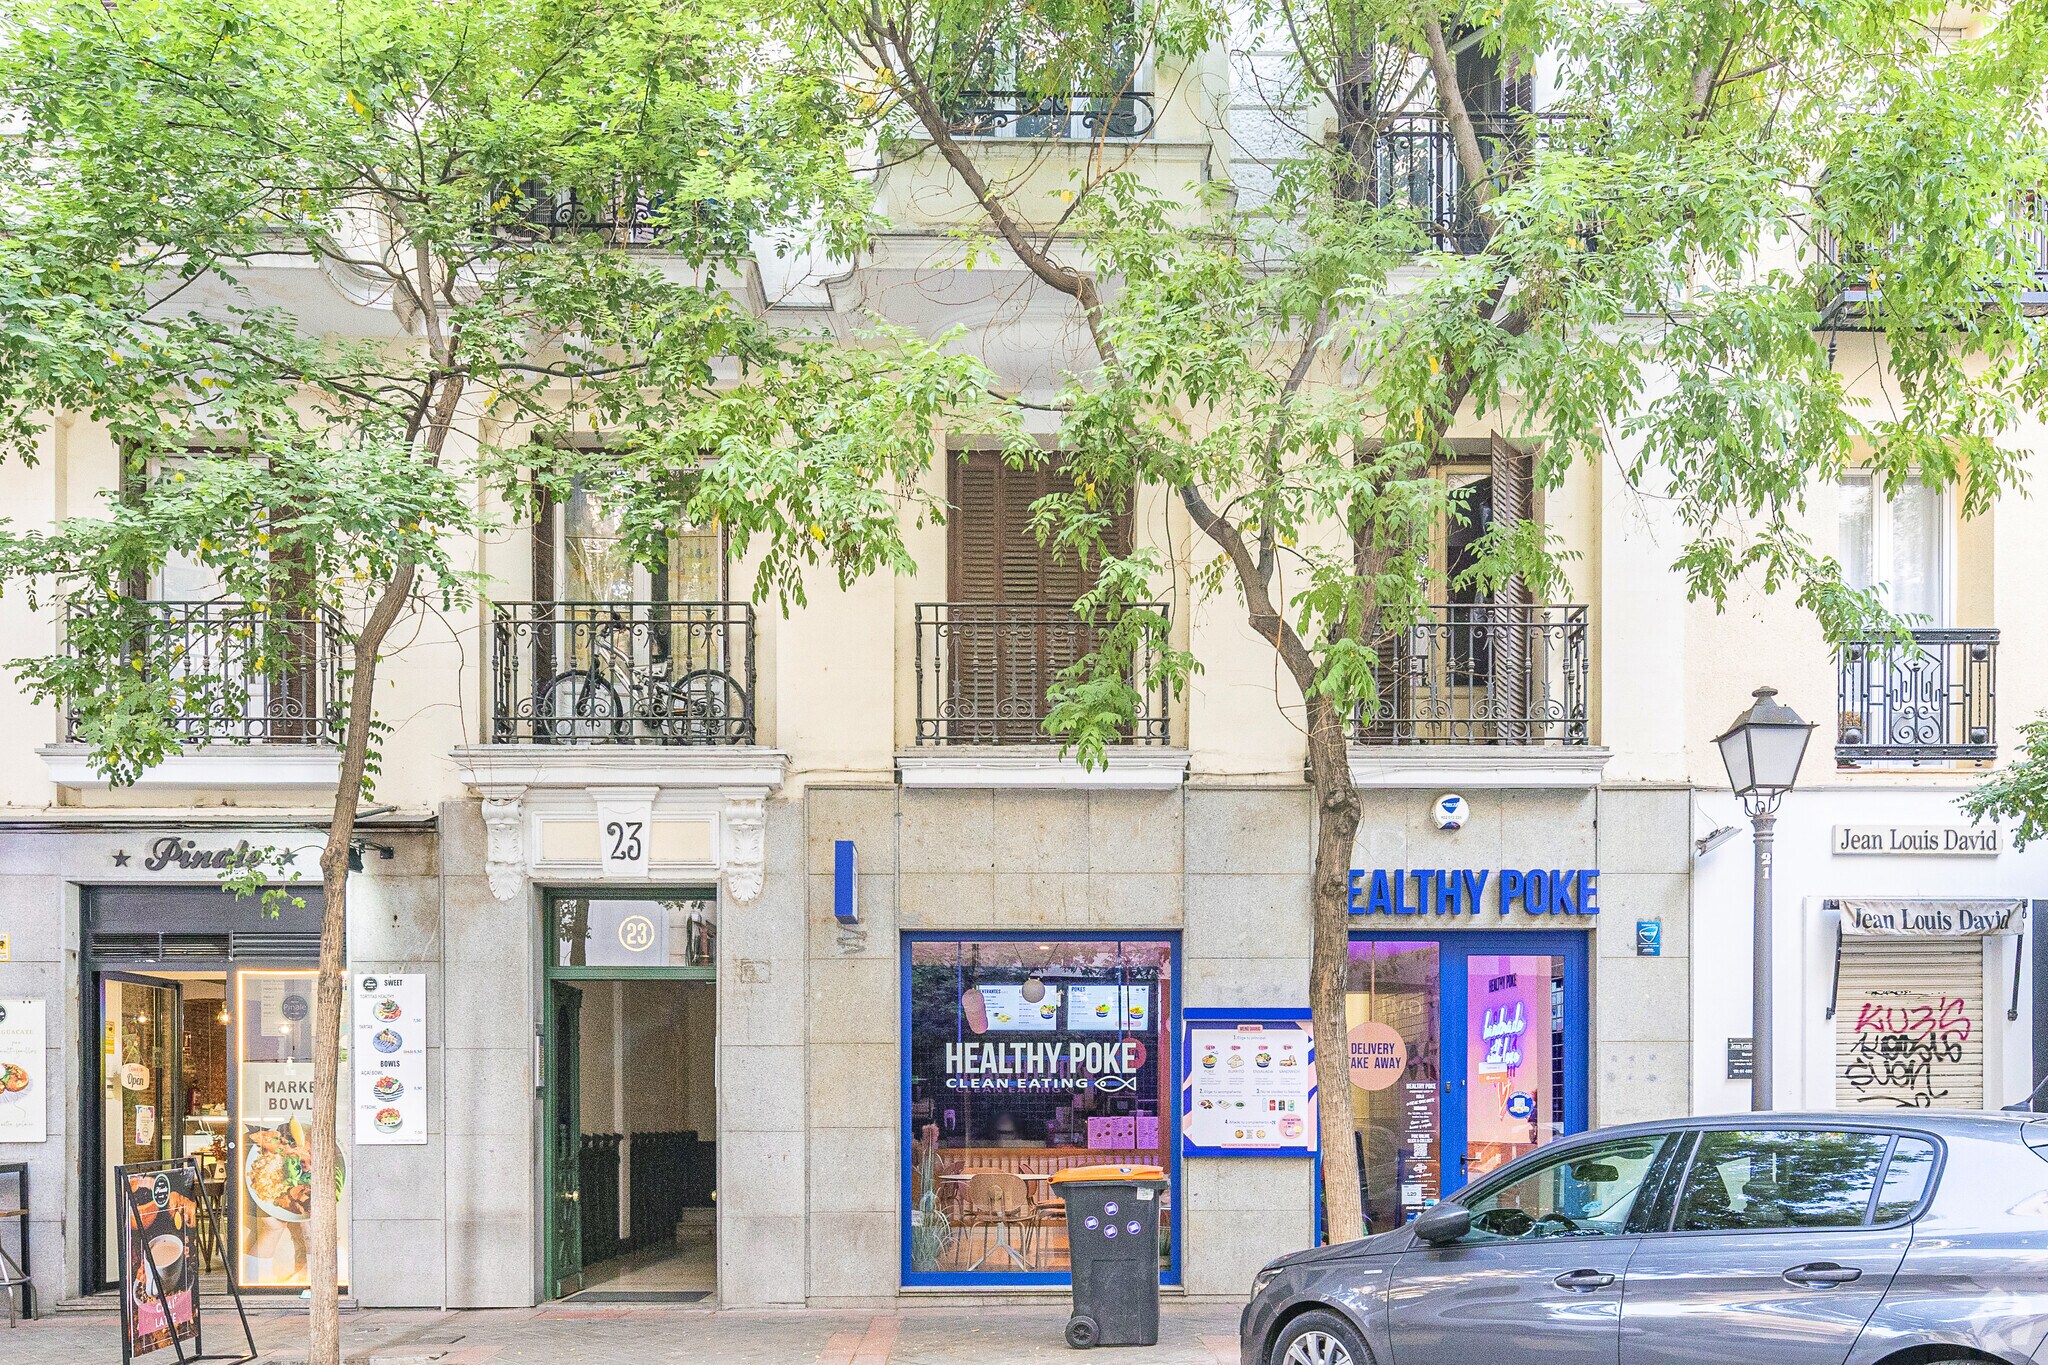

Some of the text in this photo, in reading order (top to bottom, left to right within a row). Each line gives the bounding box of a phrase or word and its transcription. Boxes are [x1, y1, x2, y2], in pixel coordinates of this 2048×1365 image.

[606, 821, 643, 860] 23
[1840, 828, 1998, 851] Jean Louis David
[1347, 869, 1600, 915] EALTHY POKE
[1852, 907, 2011, 931] Jean Louis David
[626, 922, 647, 945] 23
[384, 979, 403, 987] SWEET
[1351, 1042, 1395, 1055] DELIVERY
[380, 1060, 400, 1068] BOWLS
[945, 1042, 1137, 1074] HEALTHY POKE
[1348, 1056, 1402, 1069] AKE AWAY
[126, 1073, 144, 1088] Open
[264, 1080, 315, 1093] MARKE
[945, 1078, 1088, 1089] CLEAN EATING
[268, 1097, 313, 1110] BOWL
